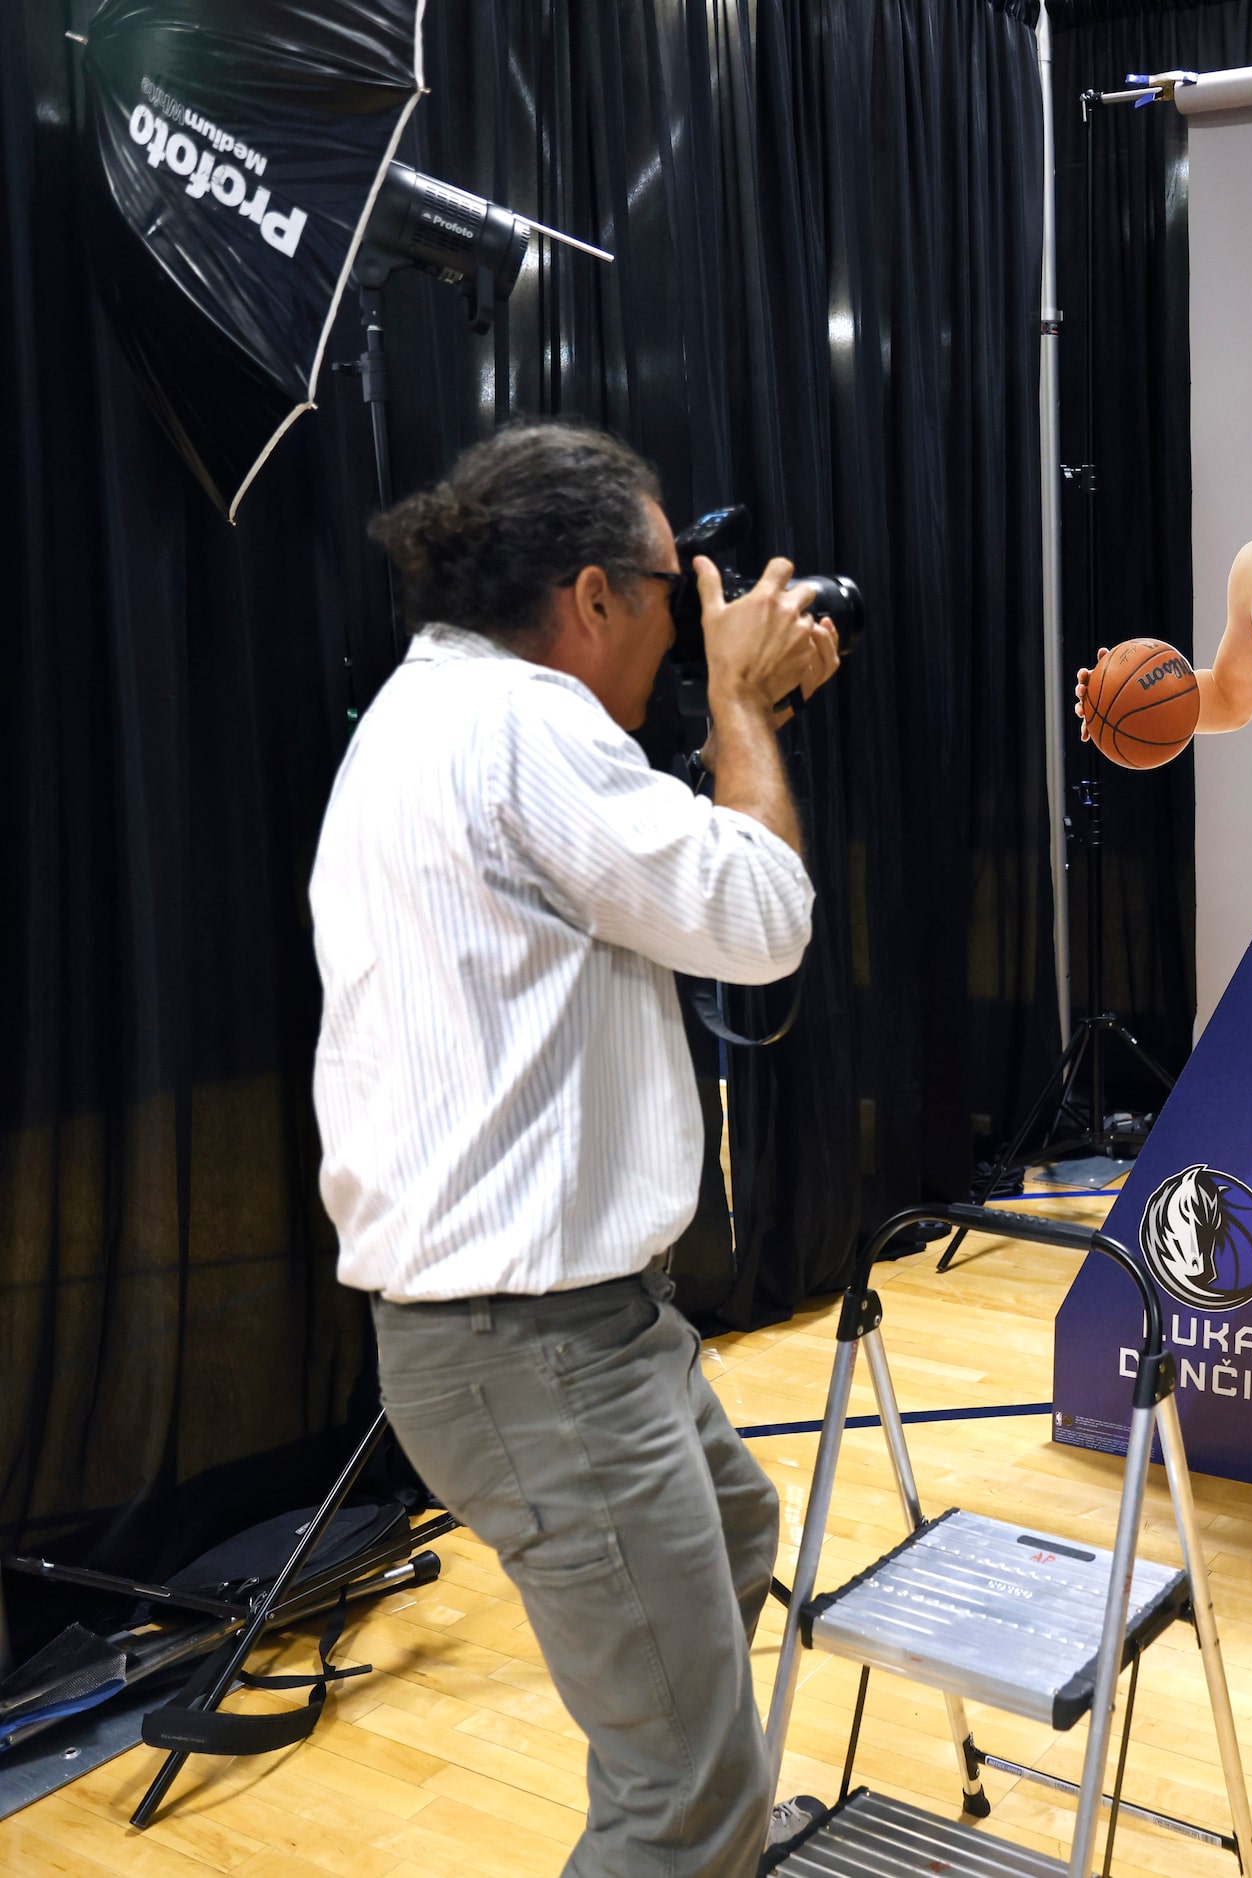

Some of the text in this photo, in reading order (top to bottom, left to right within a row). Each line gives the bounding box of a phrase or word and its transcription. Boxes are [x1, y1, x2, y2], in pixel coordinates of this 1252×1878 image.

[184, 108, 267, 176] Medium
[129, 104, 308, 258] Profoto
[433, 215, 474, 239] Profoto
